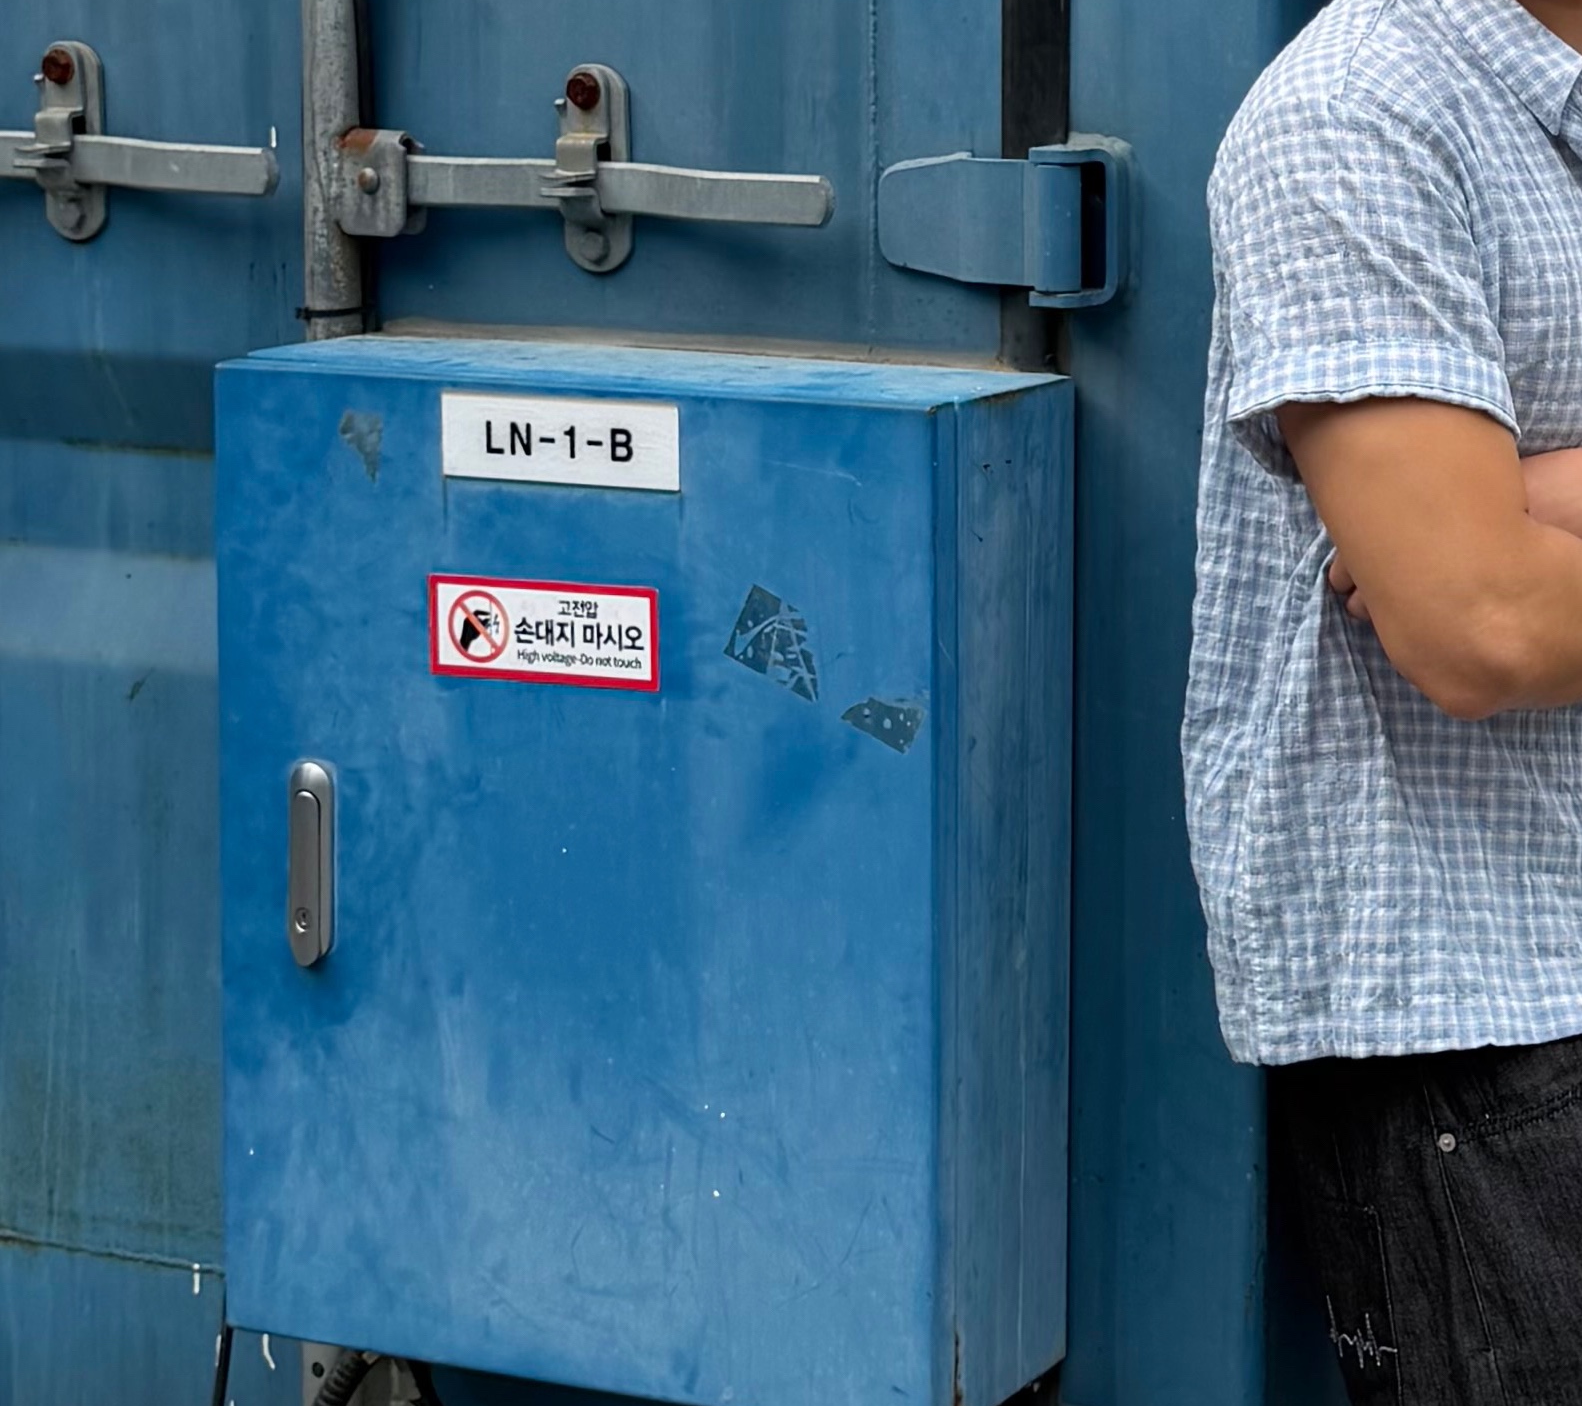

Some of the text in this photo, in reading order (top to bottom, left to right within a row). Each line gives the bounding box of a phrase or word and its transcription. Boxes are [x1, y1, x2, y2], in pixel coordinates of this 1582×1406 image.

[485, 420, 634, 463] LN-1-B
[557, 599, 599, 619] 고전압
[514, 615, 645, 652] 손대지 마시오
[517, 649, 540, 665] High
[596, 655, 612, 667] not
[613, 657, 642, 669] touch
